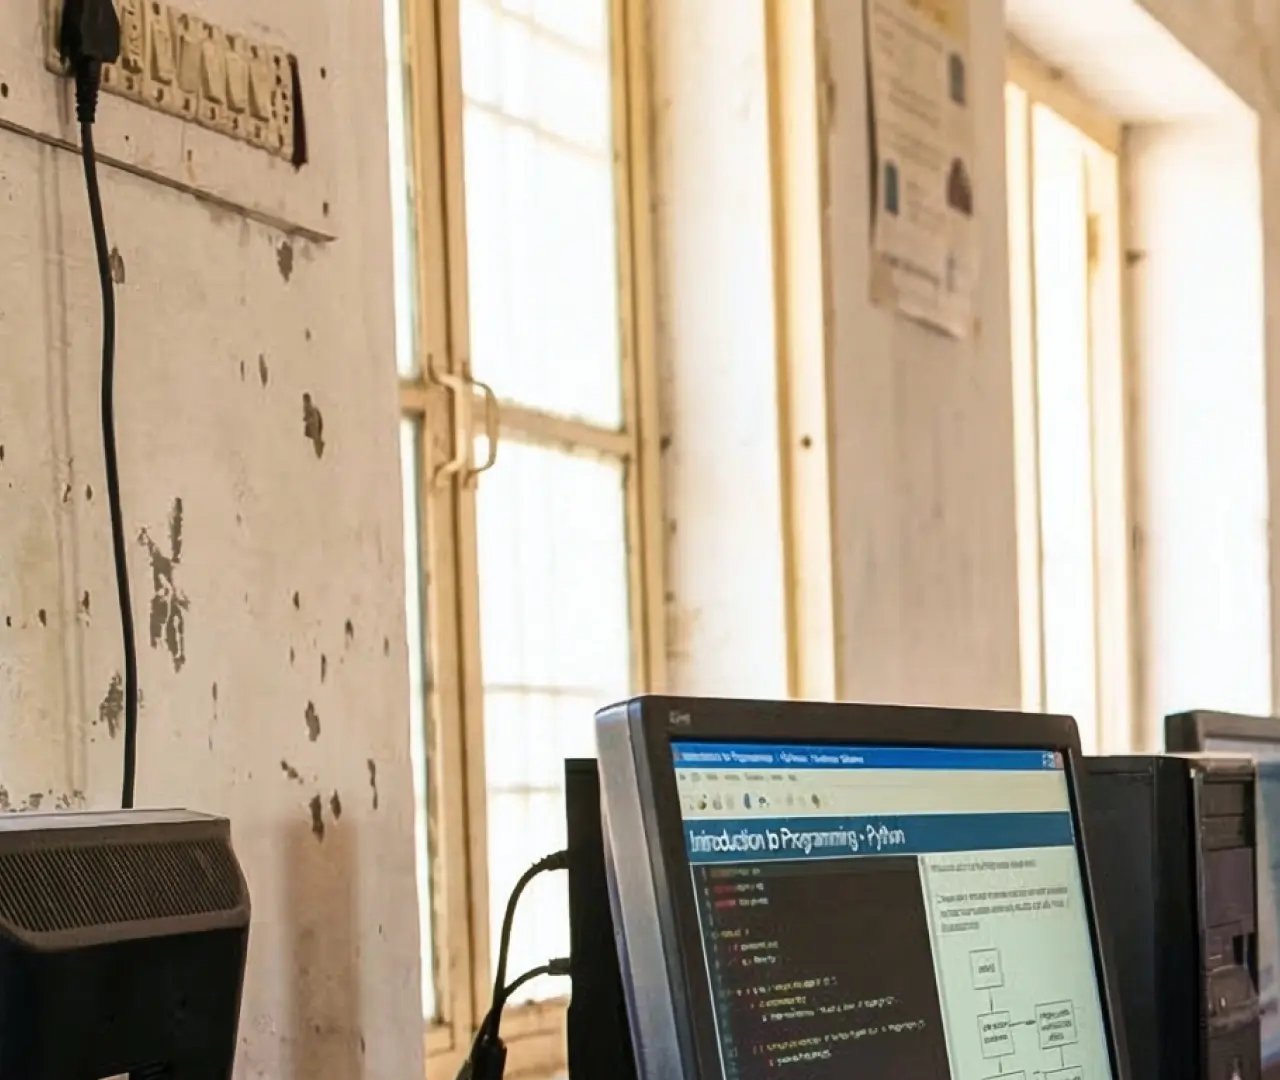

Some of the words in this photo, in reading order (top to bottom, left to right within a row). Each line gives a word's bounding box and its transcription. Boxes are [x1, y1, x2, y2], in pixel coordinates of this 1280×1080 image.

[690, 828, 764, 852] Introduction
[780, 827, 858, 855] Programming
[866, 824, 906, 852] Python
